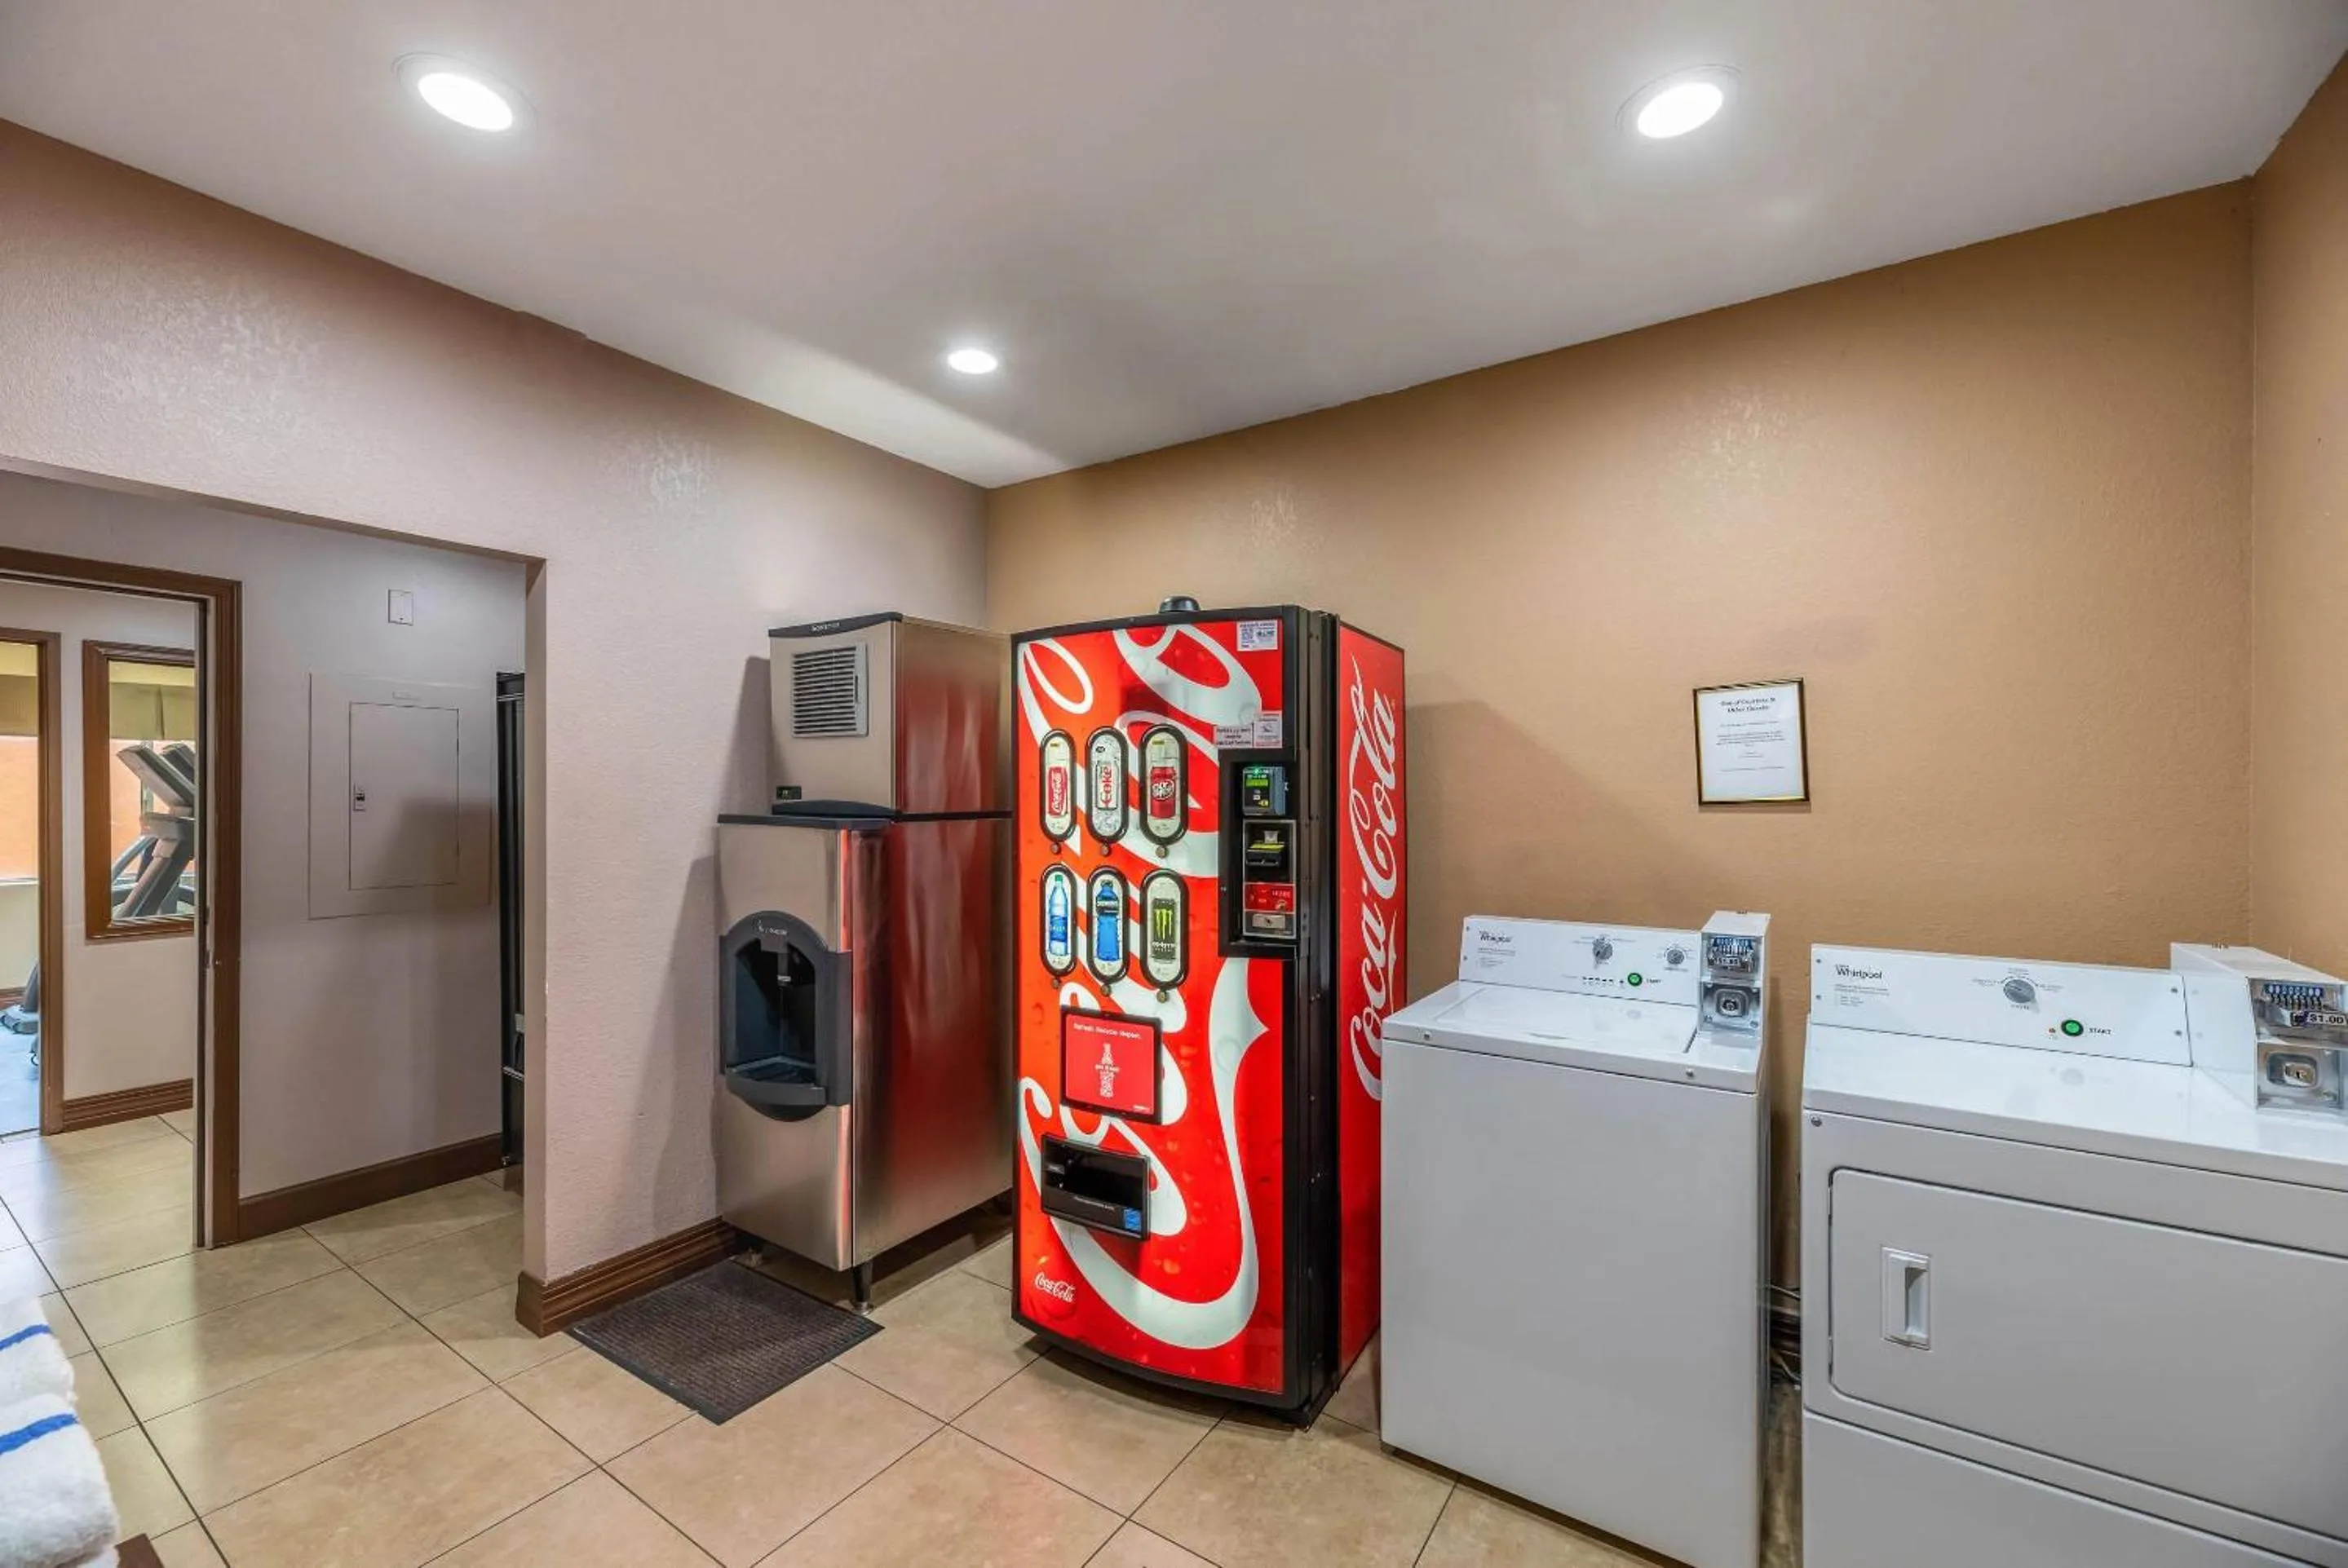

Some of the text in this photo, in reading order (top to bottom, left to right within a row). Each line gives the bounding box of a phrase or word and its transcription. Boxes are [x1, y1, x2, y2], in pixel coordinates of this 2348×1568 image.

[1101, 766, 1113, 806] Coke
[1351, 652, 1397, 1101] Coca-Cola
[1834, 964, 1883, 979] Whirlpool
[1034, 1270, 1076, 1303] Coca-Cola
